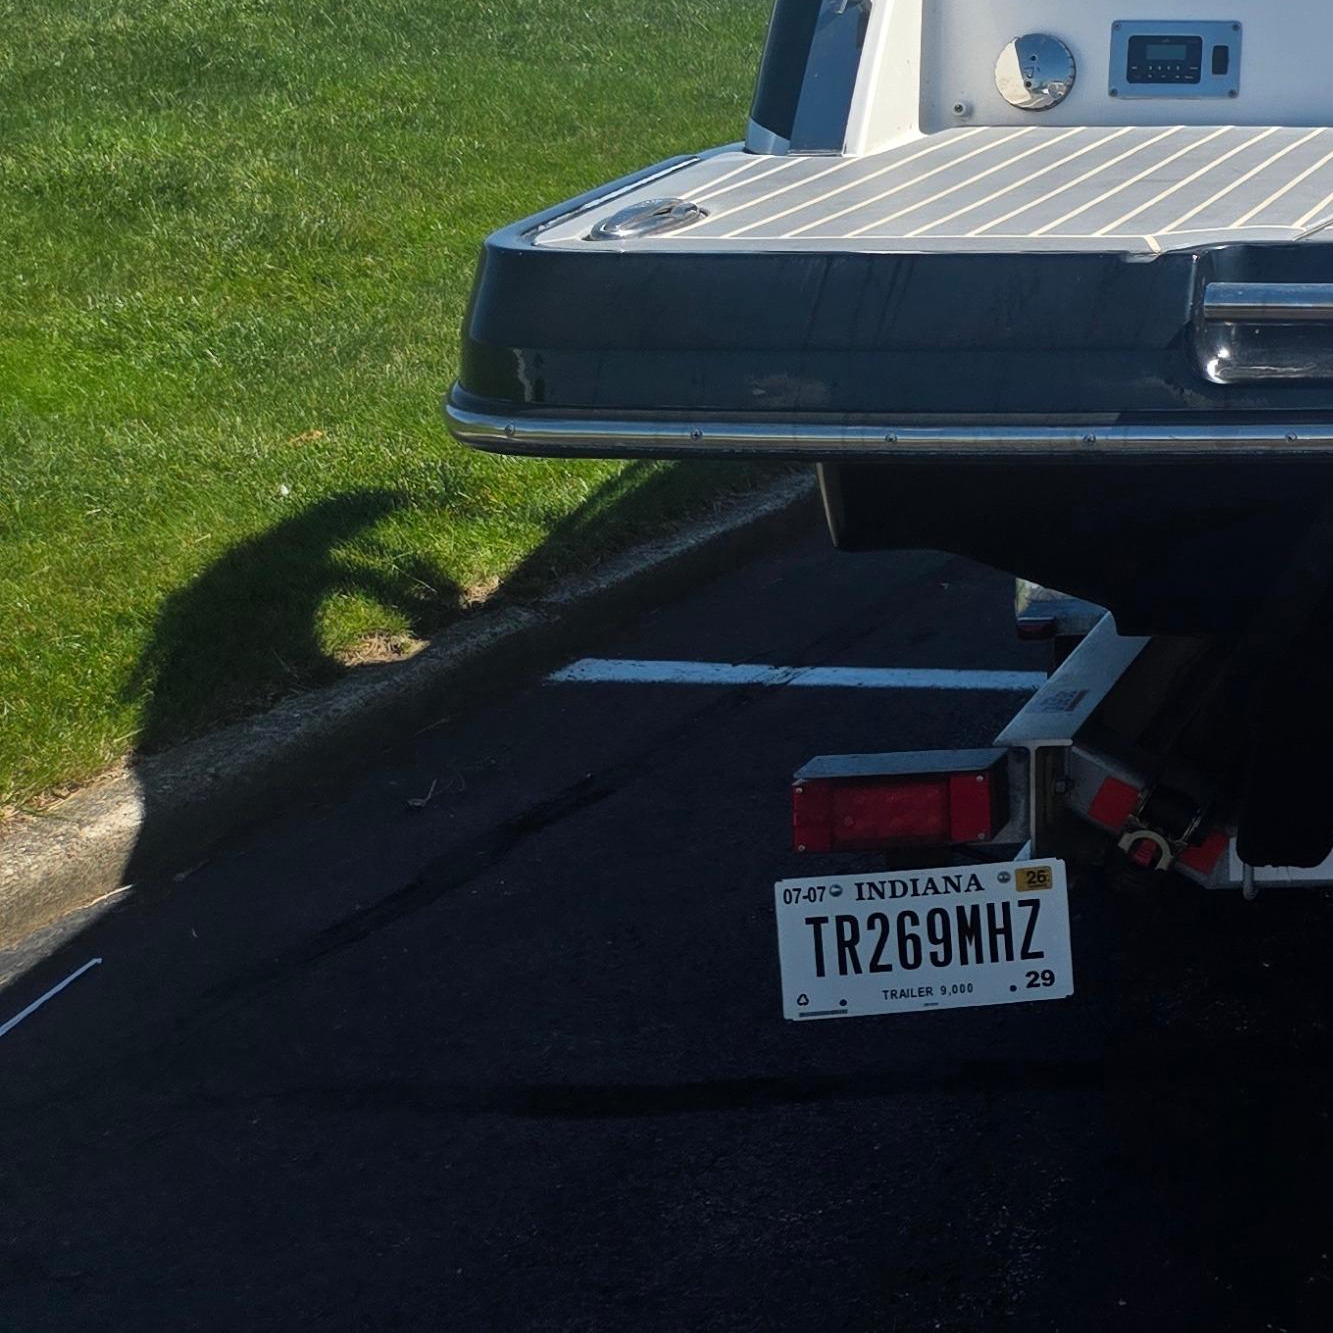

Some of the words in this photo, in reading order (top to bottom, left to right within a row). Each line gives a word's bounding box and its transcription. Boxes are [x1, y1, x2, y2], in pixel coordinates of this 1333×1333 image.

[783, 886, 826, 905] 07-07
[855, 873, 985, 901] INDIANA
[1026, 870, 1047, 884] 26
[805, 898, 1045, 978] TR269MHZ
[882, 985, 934, 1001] TRAILER
[940, 983, 974, 998] 9,000
[1025, 970, 1055, 989] 29
